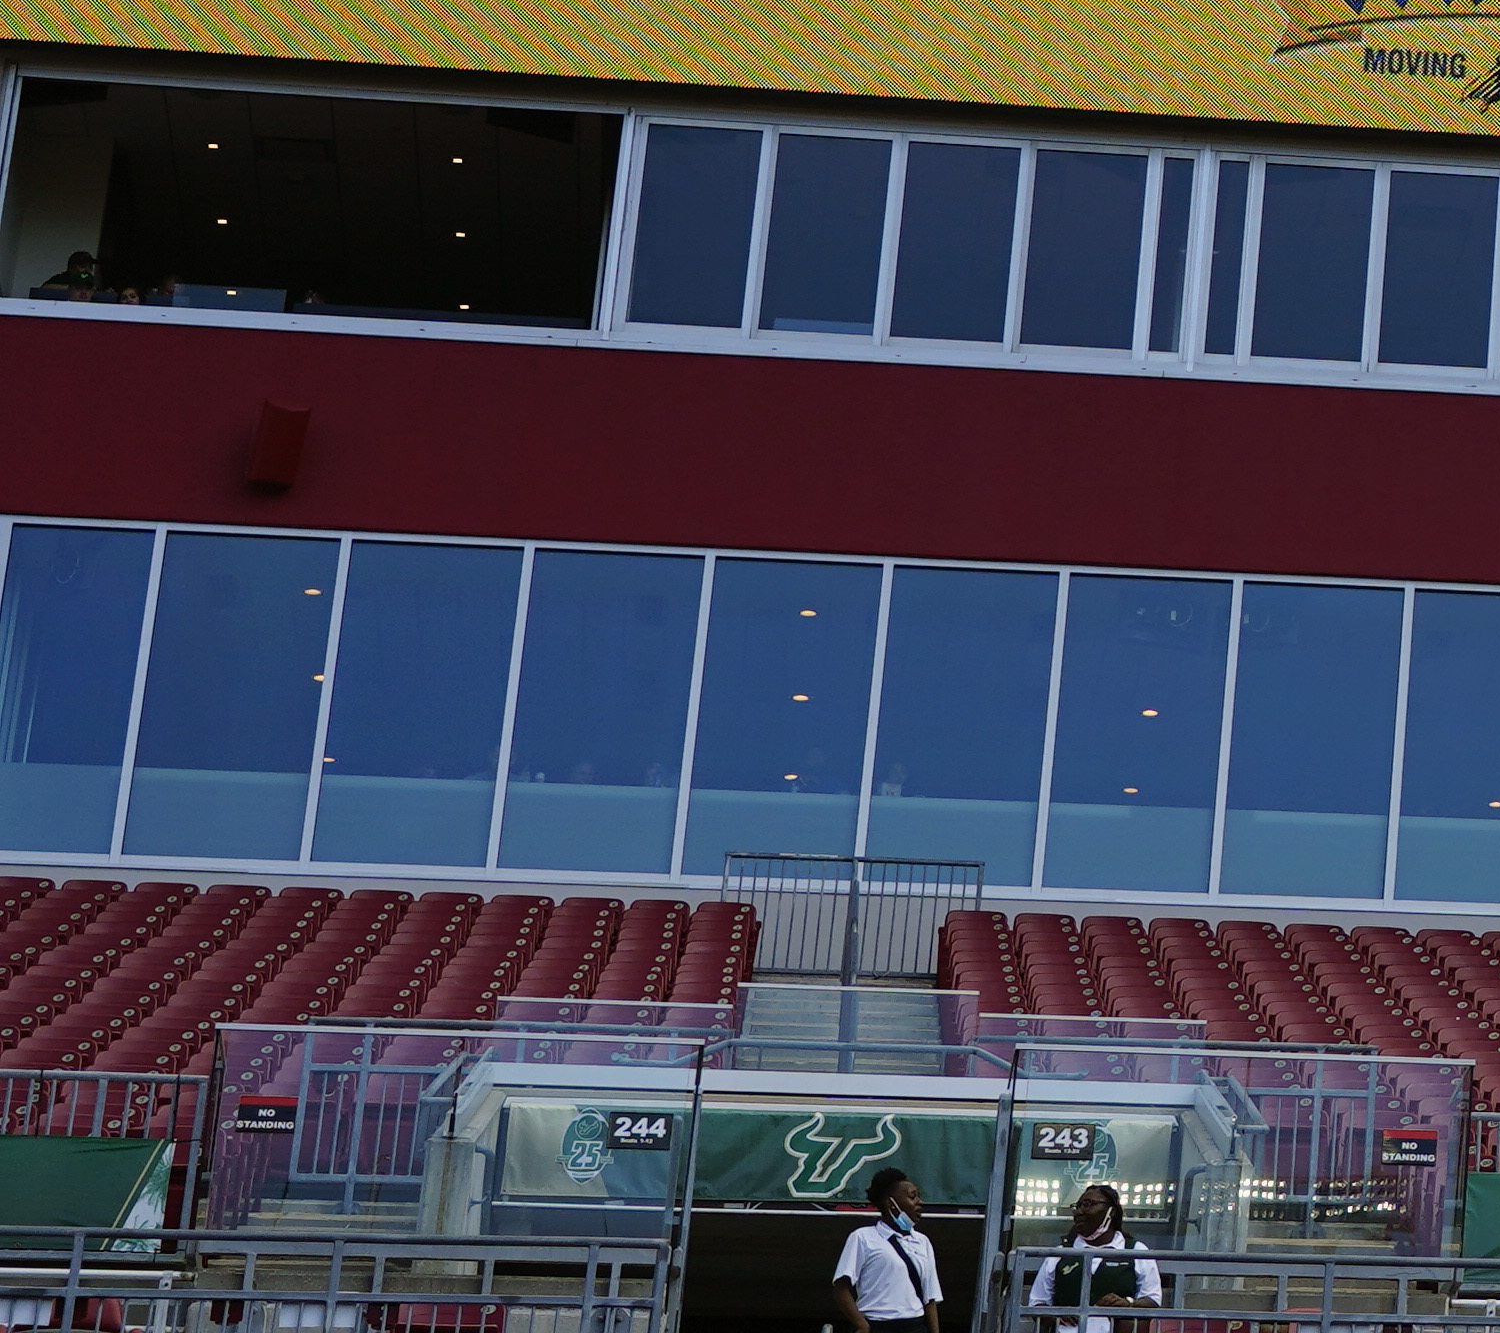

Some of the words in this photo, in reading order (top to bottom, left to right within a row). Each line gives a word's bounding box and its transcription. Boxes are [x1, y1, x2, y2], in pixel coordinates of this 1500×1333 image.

[1362, 47, 1467, 79] MOVING
[258, 1108, 276, 1117] NO
[236, 1120, 295, 1130] STANDING
[613, 1116, 667, 1139] 244
[1038, 1127, 1089, 1149] 243
[1401, 1142, 1418, 1150] NO
[568, 1141, 604, 1170] 25
[1382, 1153, 1436, 1163] STANDING
